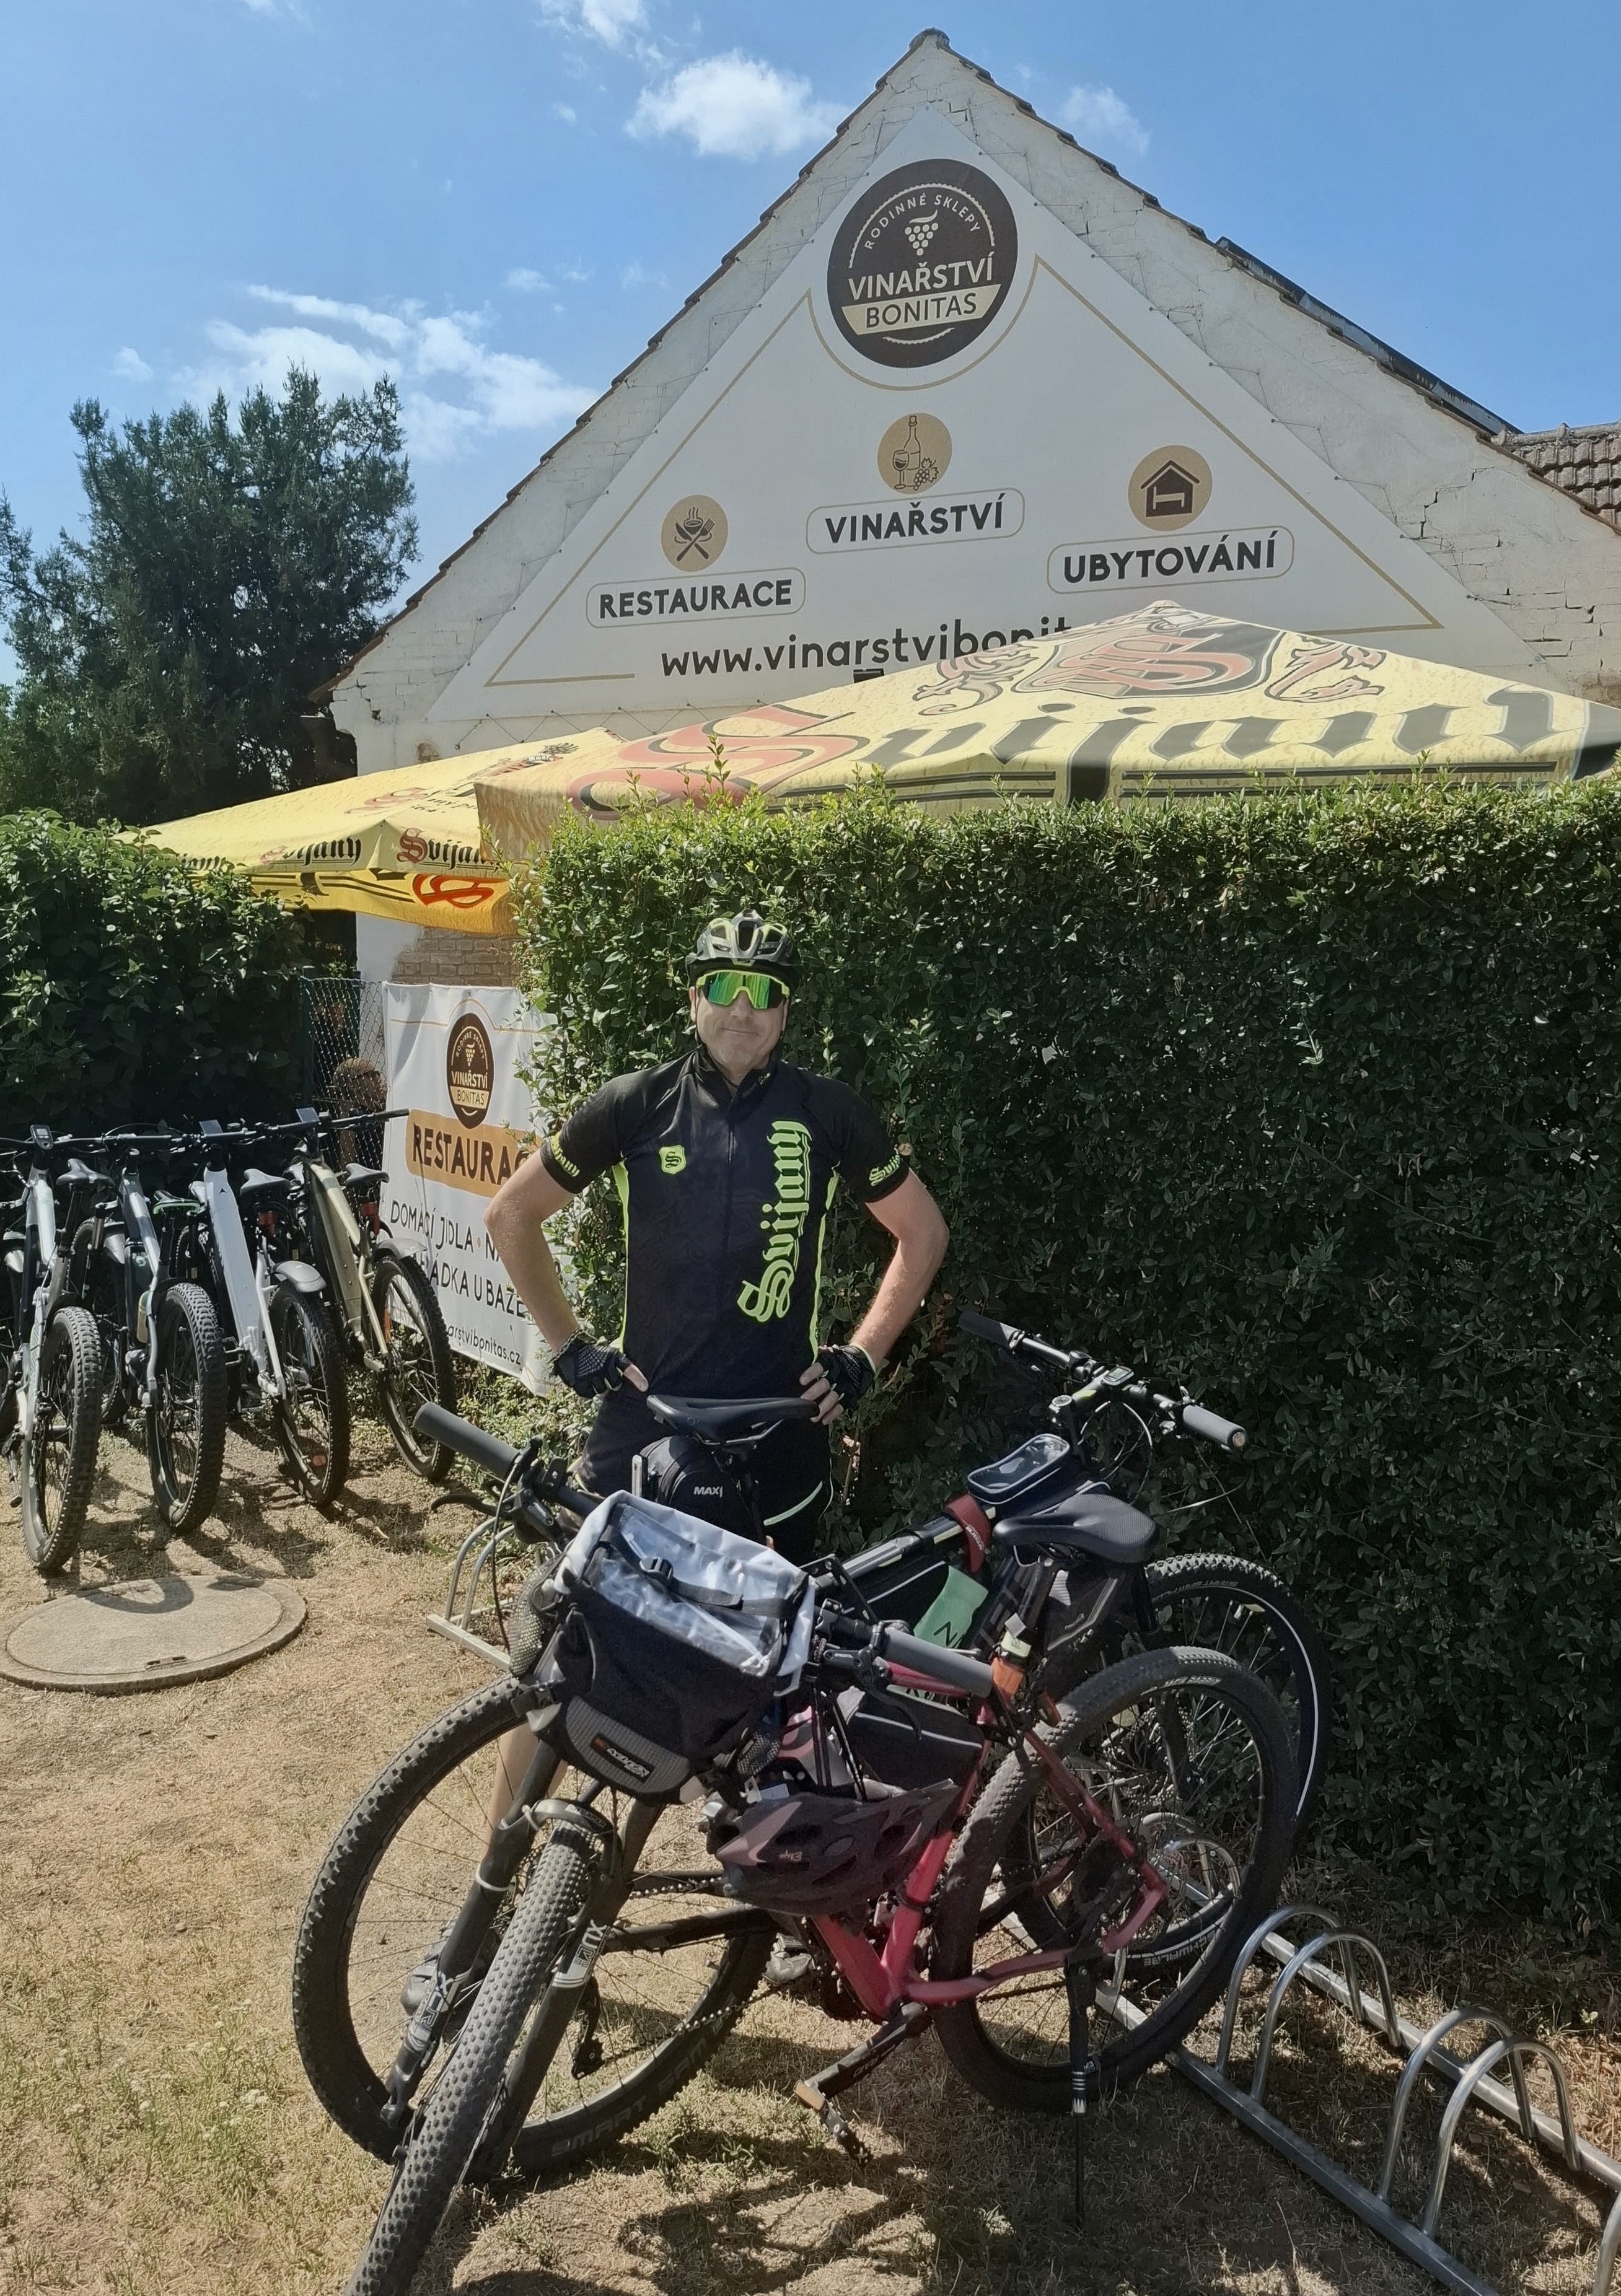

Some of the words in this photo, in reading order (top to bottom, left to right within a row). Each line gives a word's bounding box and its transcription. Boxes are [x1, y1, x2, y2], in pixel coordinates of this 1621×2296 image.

[864, 193, 927, 249] RODINNÉ
[934, 194, 980, 233] SKLEPY
[848, 251, 995, 300] VINAŘSTVÍ
[866, 292, 977, 328] BONITAS
[825, 493, 1006, 544] VINAŘSTVÍ
[1063, 530, 1279, 584] UBYTOVÁNÍ
[599, 579, 793, 619] RESTAURACE
[451, 1069, 488, 1089] VINAŘSTVÍ
[457, 1089, 485, 1105] BONITAS
[390, 1199, 436, 1239] DOMÁCÍ
[435, 1212, 474, 1253] JÍDLA
[737, 1120, 812, 1322] Svijany
[474, 1273, 482, 1302] U
